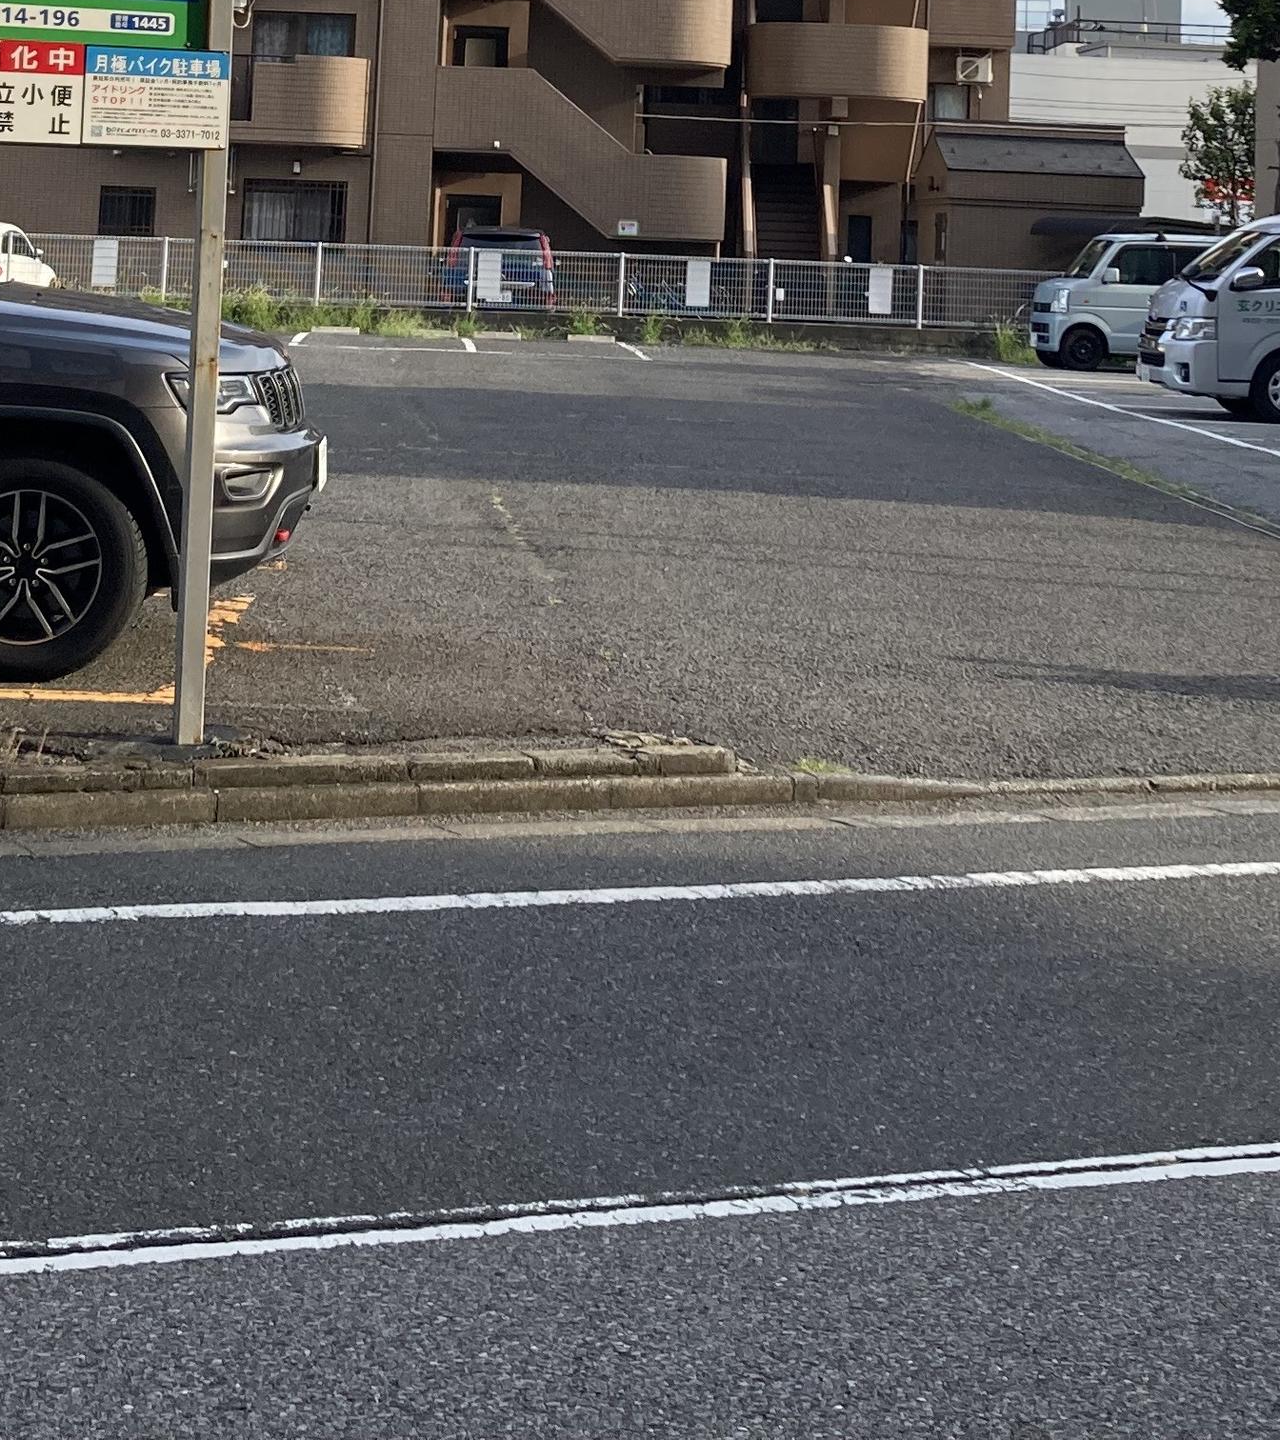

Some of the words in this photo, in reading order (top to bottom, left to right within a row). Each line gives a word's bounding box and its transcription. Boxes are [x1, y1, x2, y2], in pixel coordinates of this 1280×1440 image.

[132, 16, 166, 30] 1445
[94, 54, 221, 78] 月極バイク駐車場
[161, 128, 220, 140] 03-3371-7012
